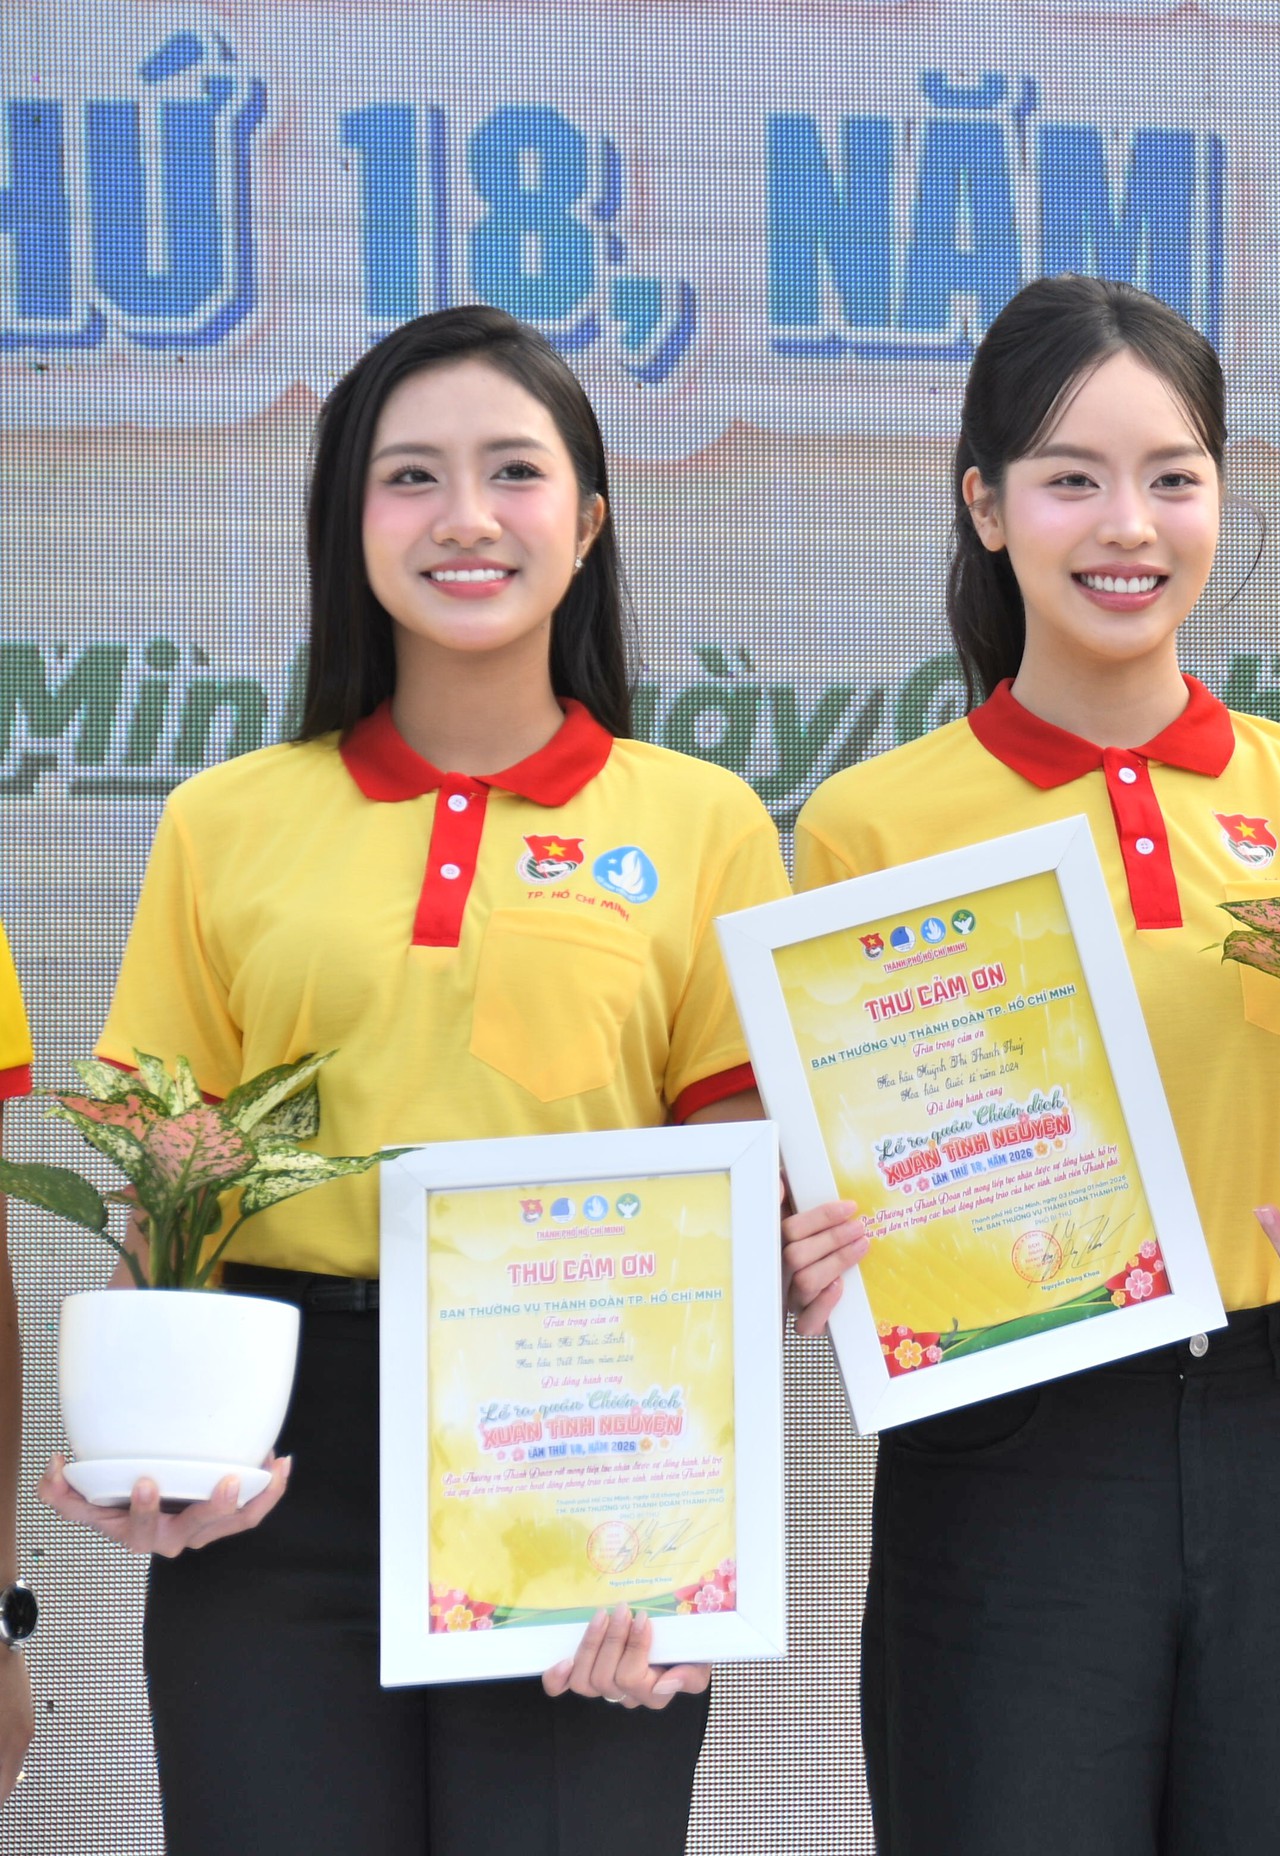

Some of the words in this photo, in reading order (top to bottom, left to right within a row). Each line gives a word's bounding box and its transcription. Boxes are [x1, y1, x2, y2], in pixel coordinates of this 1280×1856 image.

[340, 102, 692, 380] 18,
[766, 68, 1223, 358] NĂM
[527, 891, 545, 899] TP.
[551, 889, 570, 899] HỒ
[575, 894, 595, 905] CHÍ
[600, 900, 629, 922] MINH
[883, 959, 907, 973] THÀNH
[905, 951, 924, 967] PHỐ
[921, 949, 935, 962] HỒ
[932, 947, 948, 959] CHÍ
[945, 942, 967, 953] MINH
[864, 989, 915, 1020] THƯ
[916, 975, 970, 1006] CẢM
[971, 964, 1007, 990] ƠN
[810, 1053, 837, 1068] BAN
[838, 1038, 888, 1059] THƯỜNG
[889, 1032, 907, 1045] VỤ
[908, 1020, 949, 1039] THÀNH
[950, 1010, 985, 1028] ĐOÀN
[986, 1005, 1005, 1017] TP.
[1007, 998, 1025, 1011] HỒ
[1026, 992, 1047, 1006] CHÍ
[1048, 984, 1075, 999] MNH
[998, 1060, 1019, 1075] 2024
[875, 1137, 906, 1161] Lễ
[905, 1136, 929, 1148] ra
[930, 1120, 973, 1145] quân
[972, 1103, 1024, 1126] Chiến
[1025, 1090, 1064, 1114] dịch
[883, 1148, 942, 1186] XUÂN
[938, 1133, 990, 1162] TÌNH
[991, 1114, 1071, 1148] NGUYỆN
[930, 1171, 948, 1186] LẦN
[949, 1163, 969, 1179] THỨ
[986, 1153, 1007, 1167] NĂM
[1008, 1147, 1033, 1162] 2026
[507, 1260, 557, 1284] THƯ
[563, 1254, 615, 1280] CẢM
[621, 1254, 653, 1276] ƠN
[439, 1308, 464, 1319] BAN
[468, 1303, 520, 1316] THƯỜNG
[523, 1302, 540, 1313] VỤ
[544, 1299, 585, 1310] THÀNH
[589, 1296, 623, 1308] ĐOÀN
[627, 1295, 646, 1304] TP.
[650, 1289, 667, 1303] HỒ
[670, 1291, 691, 1302] CHÍ
[694, 1289, 721, 1299] MNH
[481, 1421, 542, 1449] XUÂN
[545, 1416, 594, 1439] TÌNH
[598, 1411, 682, 1443] NGUYỆN
